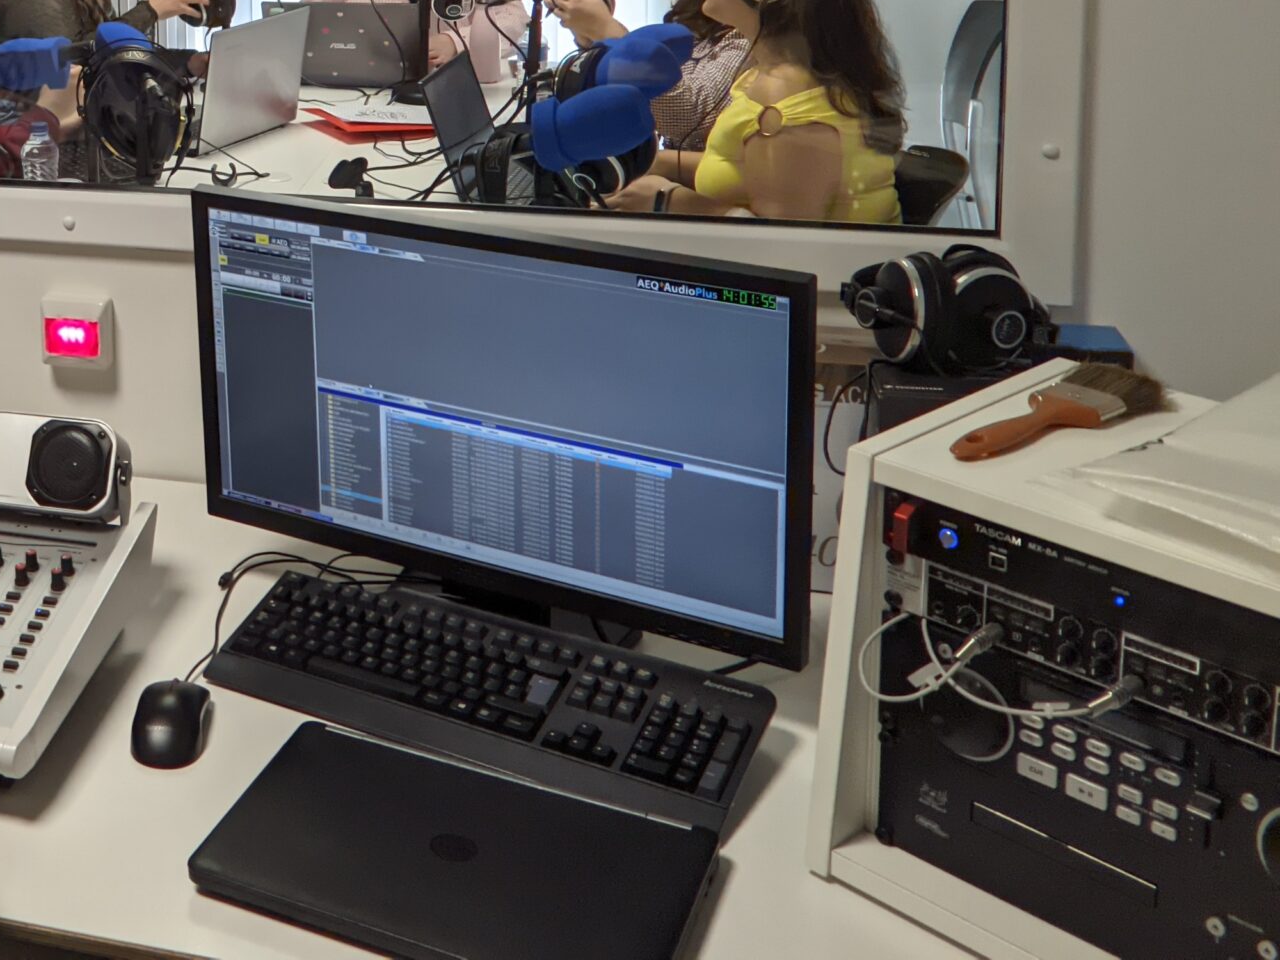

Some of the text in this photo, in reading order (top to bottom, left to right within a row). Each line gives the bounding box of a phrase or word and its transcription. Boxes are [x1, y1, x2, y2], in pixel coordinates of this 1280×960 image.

[329, 42, 357, 50] ASUS
[637, 277, 777, 310] AEQ AudioPlus 14:01:55
[974, 523, 1022, 547] TASCAM
